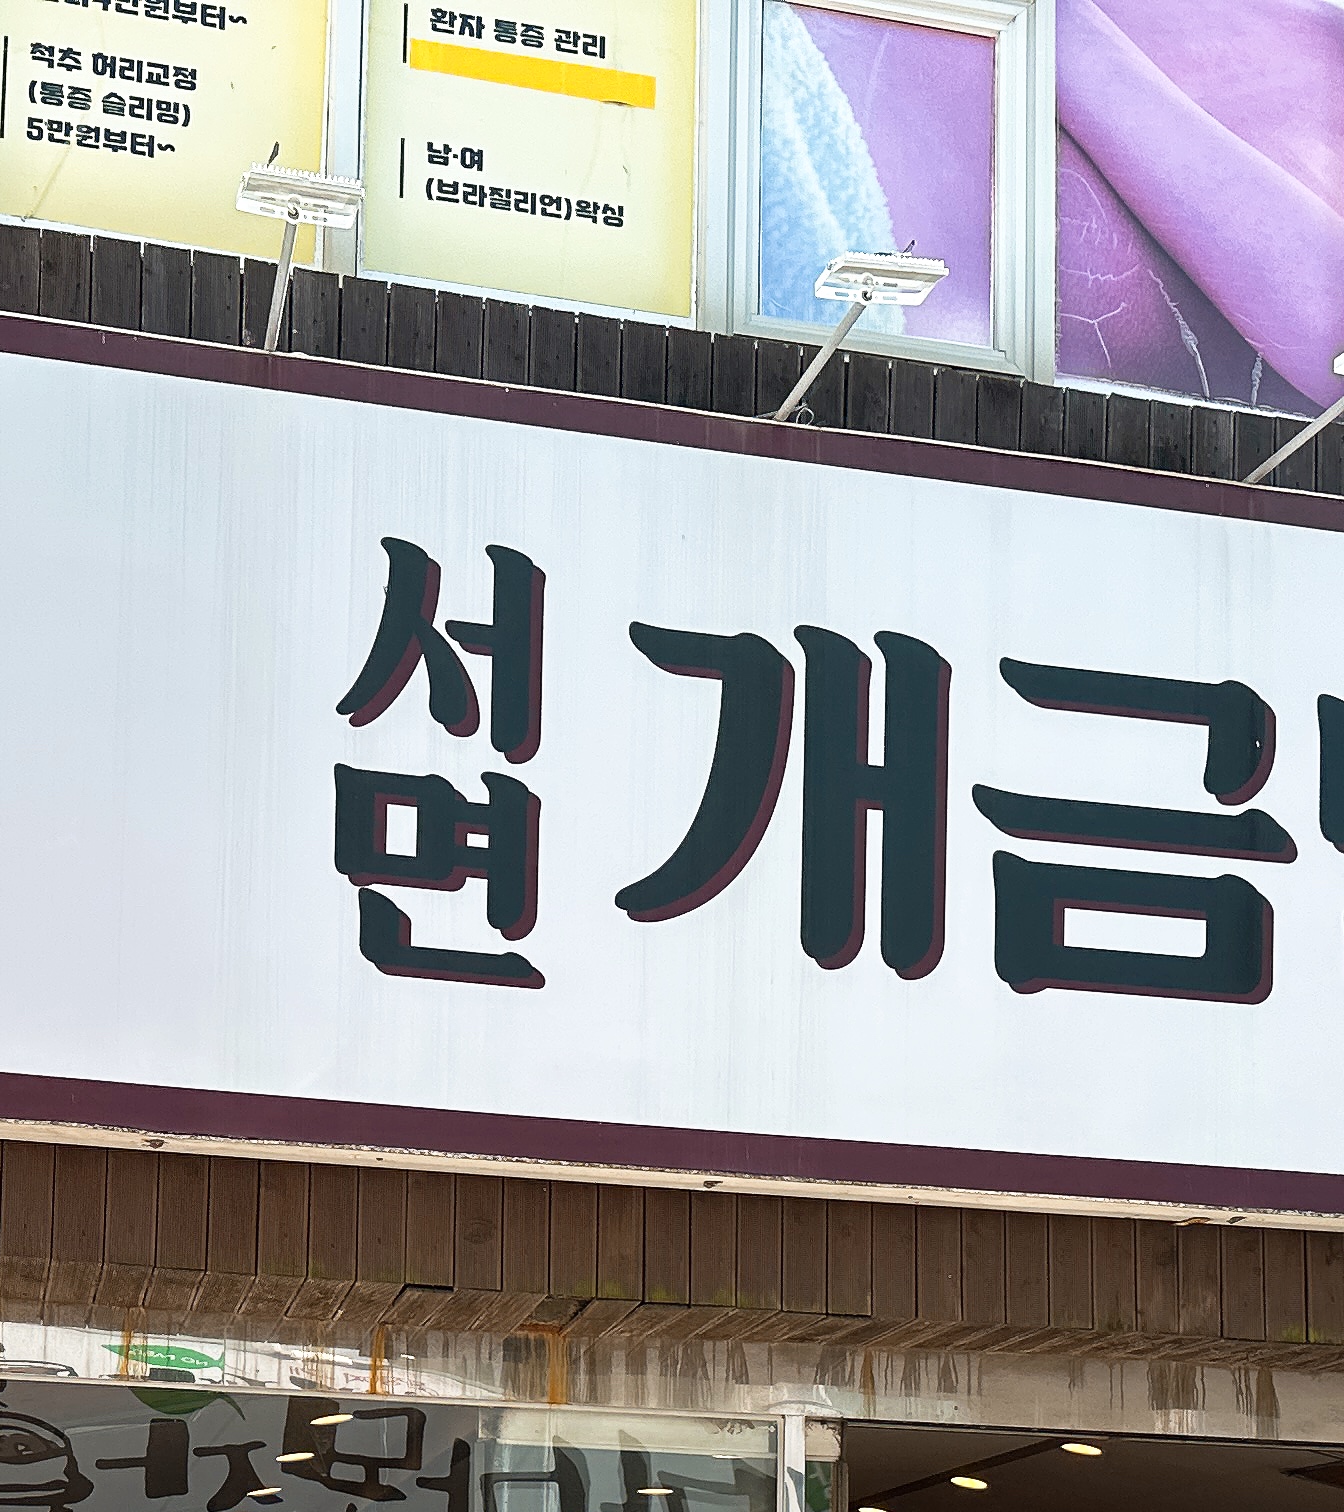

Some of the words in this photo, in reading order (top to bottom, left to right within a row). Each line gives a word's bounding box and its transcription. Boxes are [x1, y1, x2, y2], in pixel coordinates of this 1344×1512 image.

[430, 8, 485, 39] 환자
[494, 19, 544, 49] 통증
[554, 29, 605, 59] 관리
[30, 42, 82, 72] 척추
[92, 52, 197, 91] 허리교정
[29, 80, 92, 111] (통증
[102, 92, 191, 127] 슬리밍)
